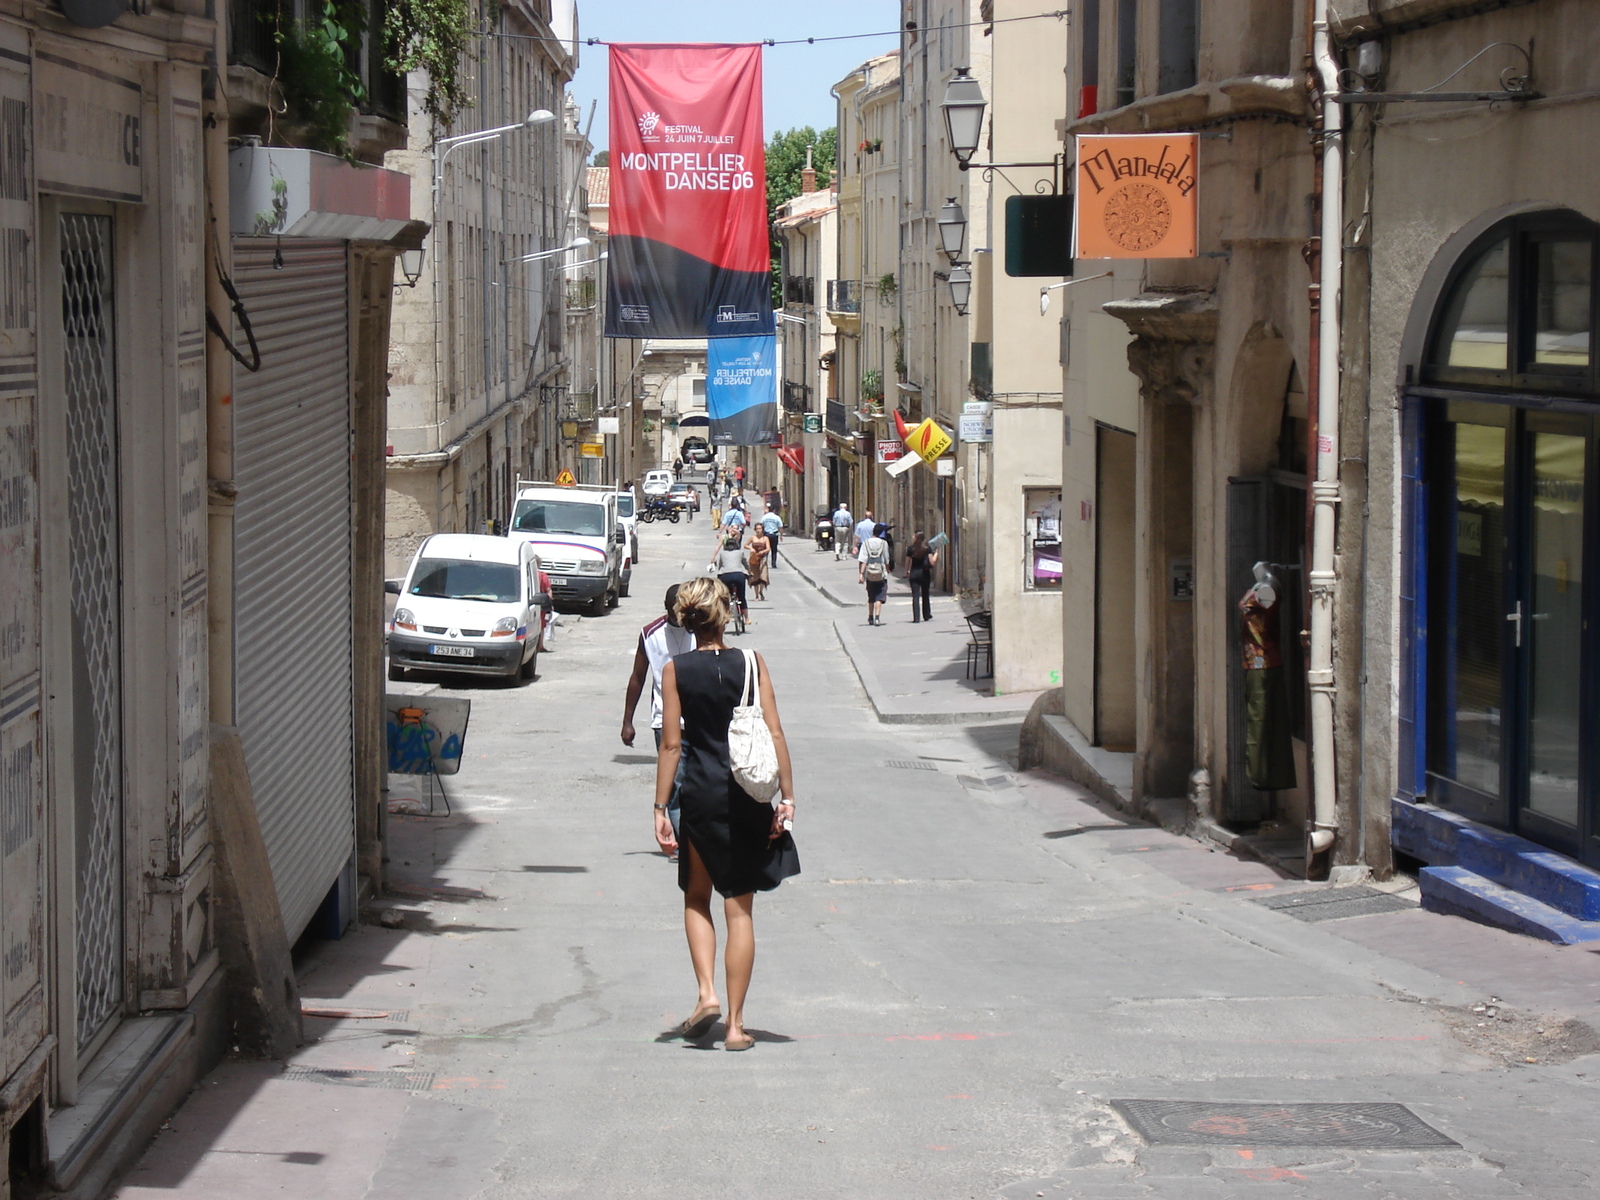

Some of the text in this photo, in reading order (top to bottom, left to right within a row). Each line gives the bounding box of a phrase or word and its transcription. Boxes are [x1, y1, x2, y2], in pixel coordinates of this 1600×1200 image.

[664, 134, 675, 143] 24
[676, 134, 696, 143] JUIN
[697, 134, 703, 143] 7
[703, 134, 735, 144] JUILLET
[665, 125, 704, 134] FESTIVAL
[620, 152, 745, 171] MONTPELLIER
[1079, 144, 1197, 198] Mandala
[925, 437, 948, 462] PRESSE
